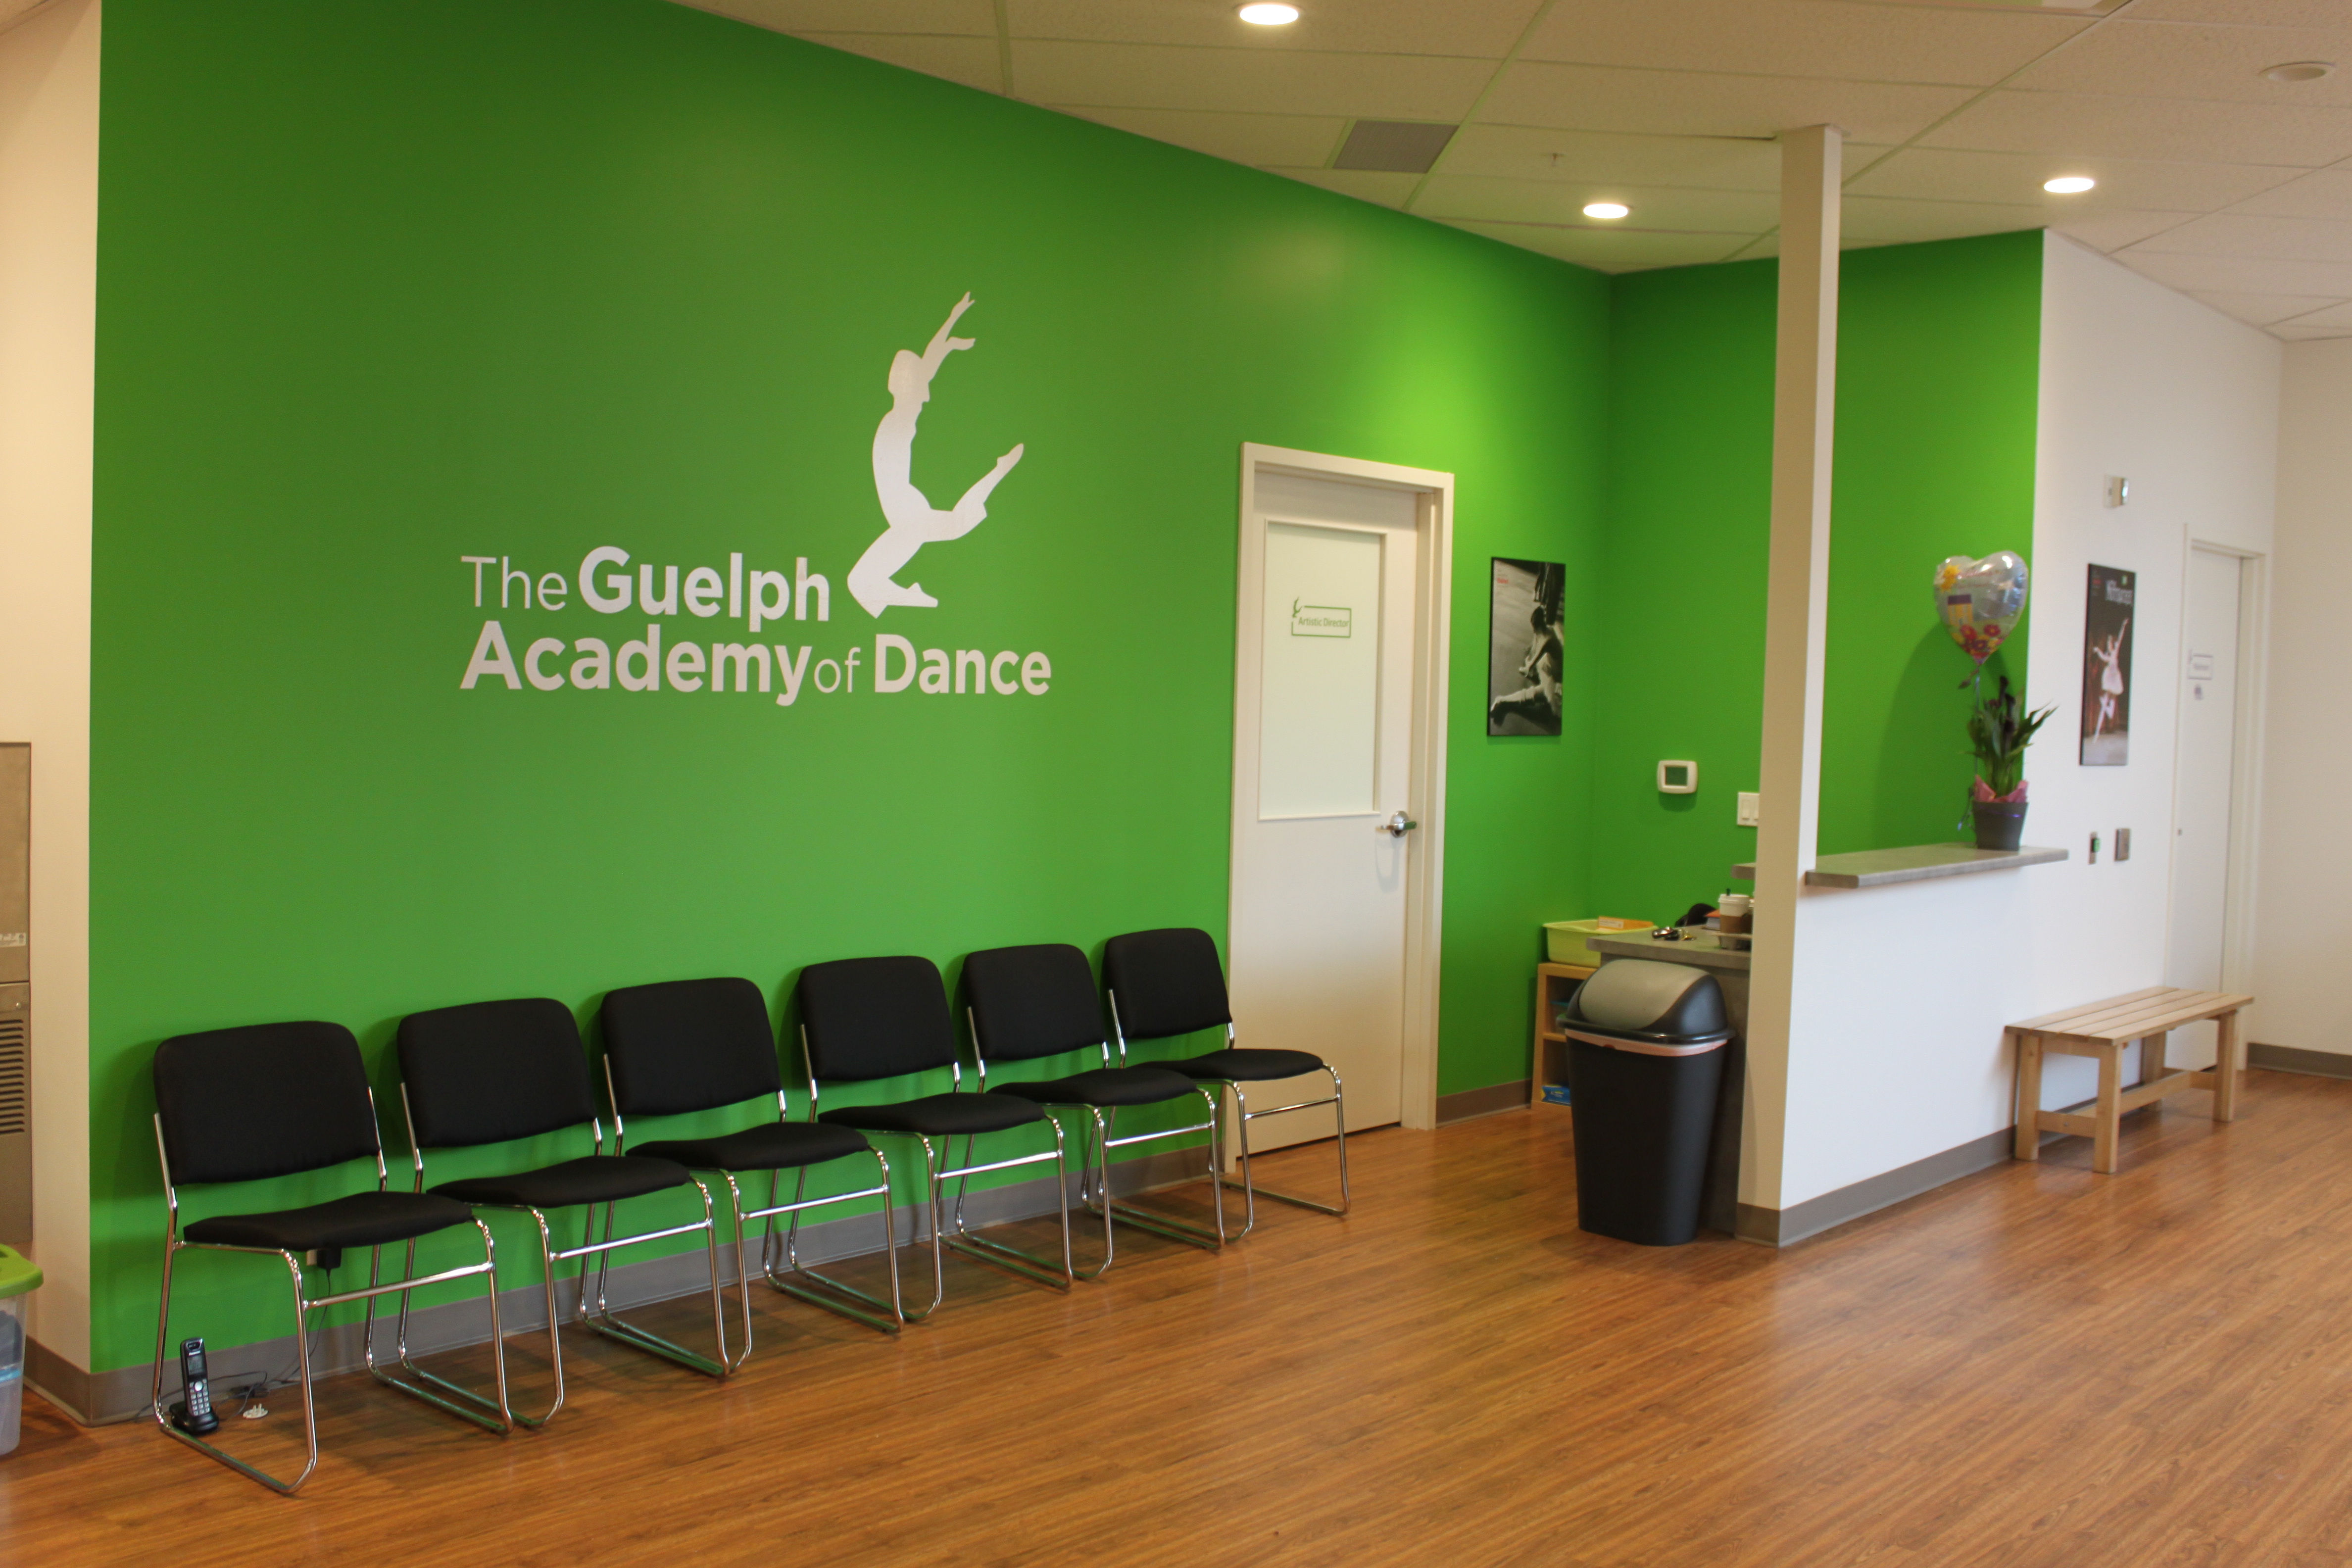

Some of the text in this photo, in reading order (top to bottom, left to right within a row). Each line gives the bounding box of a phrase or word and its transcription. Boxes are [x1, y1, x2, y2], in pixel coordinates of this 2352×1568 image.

[461, 545, 830, 633] The Guelph
[1299, 617, 1349, 627] Artistic Director
[460, 620, 1052, 707] Academy of Dance
